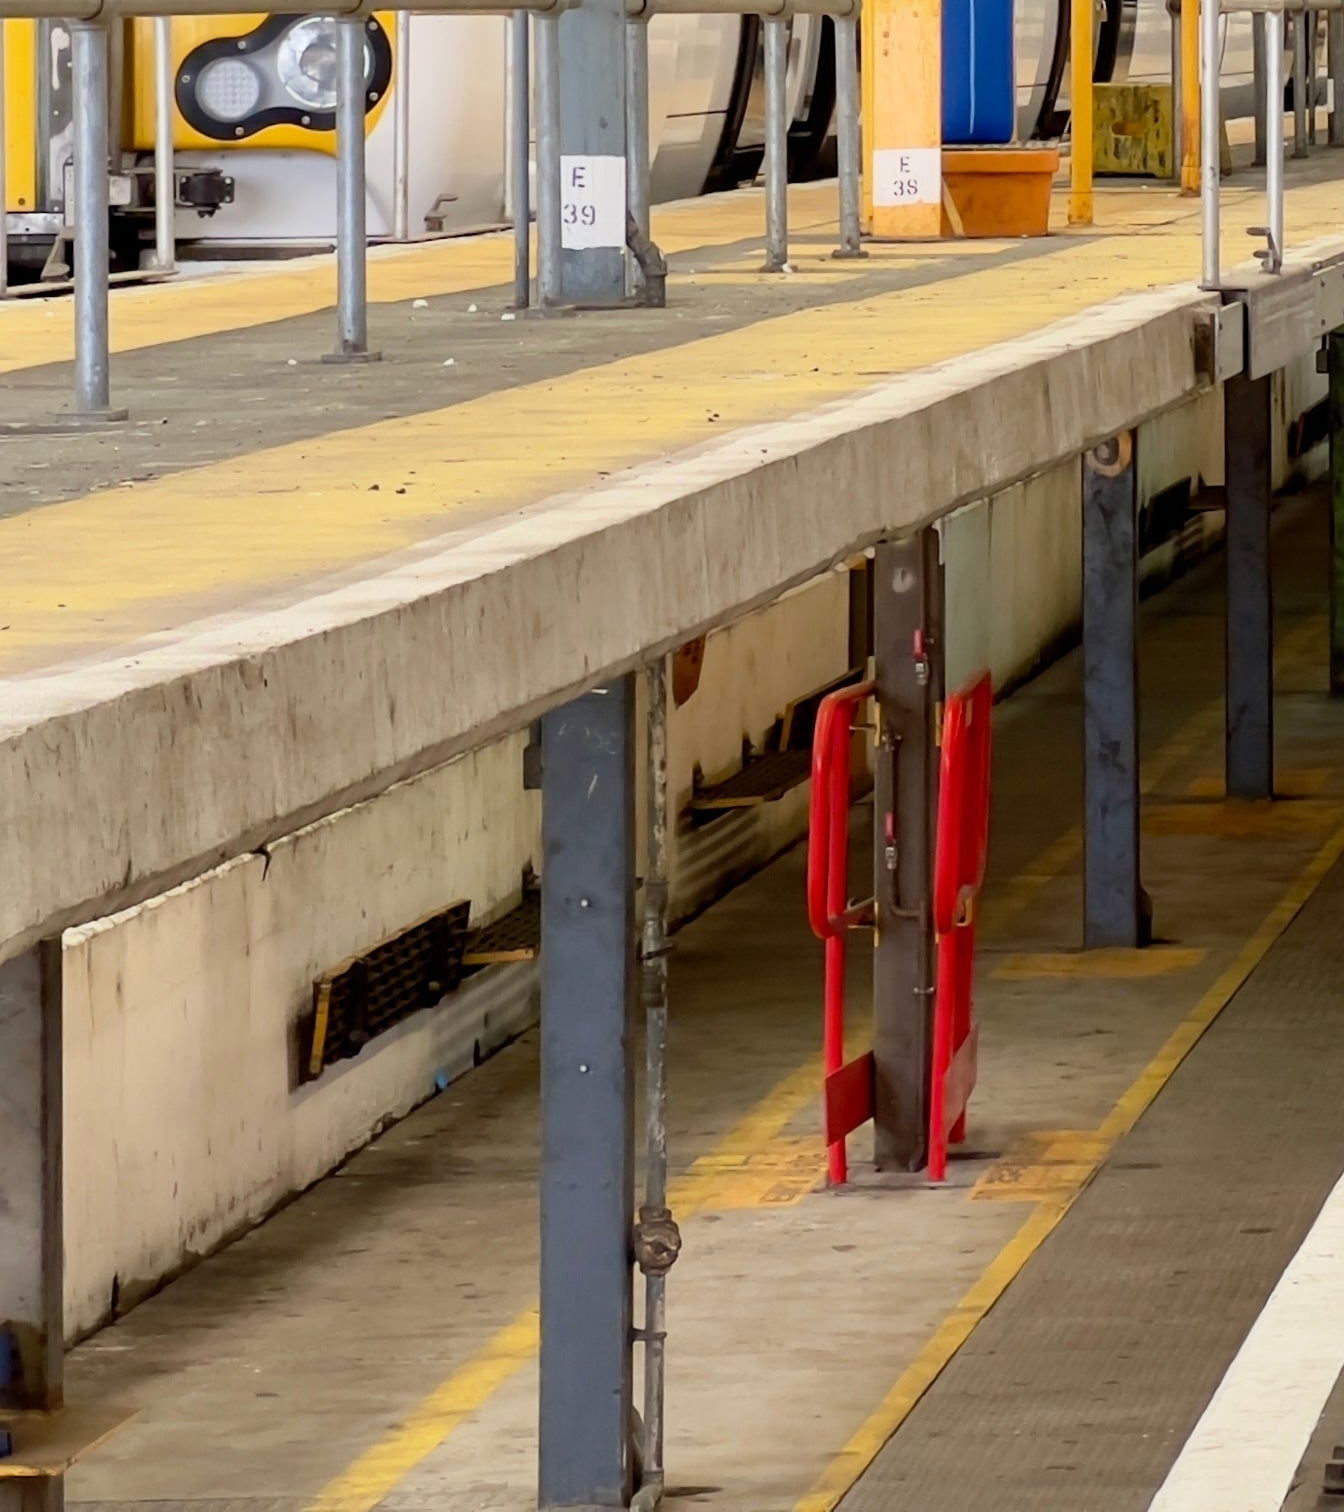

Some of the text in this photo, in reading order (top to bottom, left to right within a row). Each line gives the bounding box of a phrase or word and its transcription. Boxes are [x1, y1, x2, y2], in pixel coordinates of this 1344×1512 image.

[900, 155, 911, 173] E
[571, 166, 587, 188] E
[563, 203, 596, 226] 39
